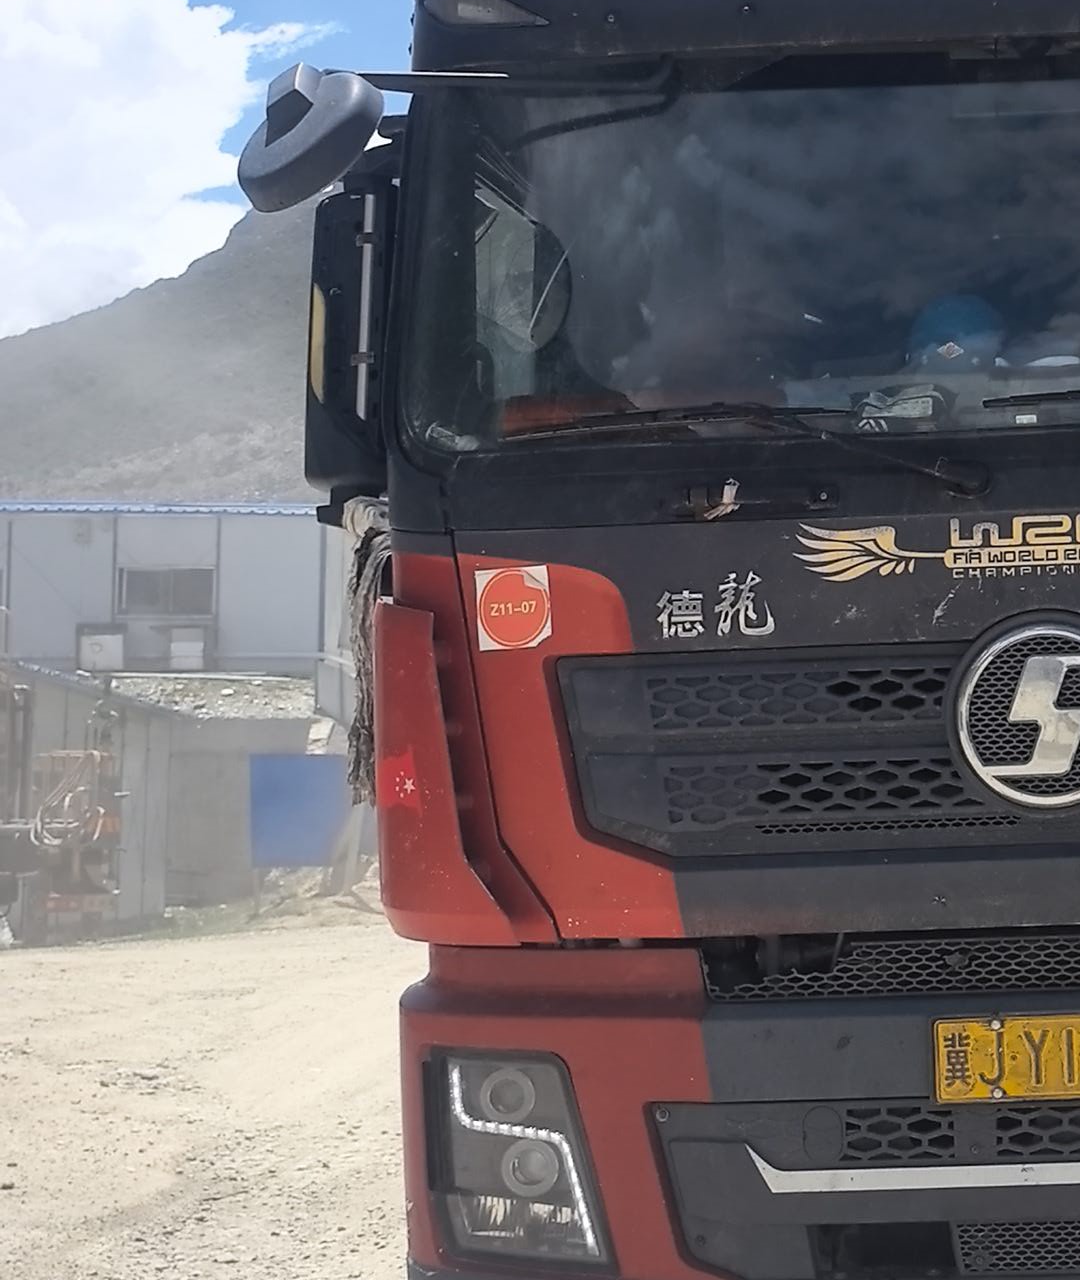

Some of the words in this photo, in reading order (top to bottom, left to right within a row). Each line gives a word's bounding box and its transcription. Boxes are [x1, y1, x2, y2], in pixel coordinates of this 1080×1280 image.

[953, 549, 982, 565] FIA
[988, 548, 1059, 563] WORLD
[489, 600, 537, 618] Z11-07
